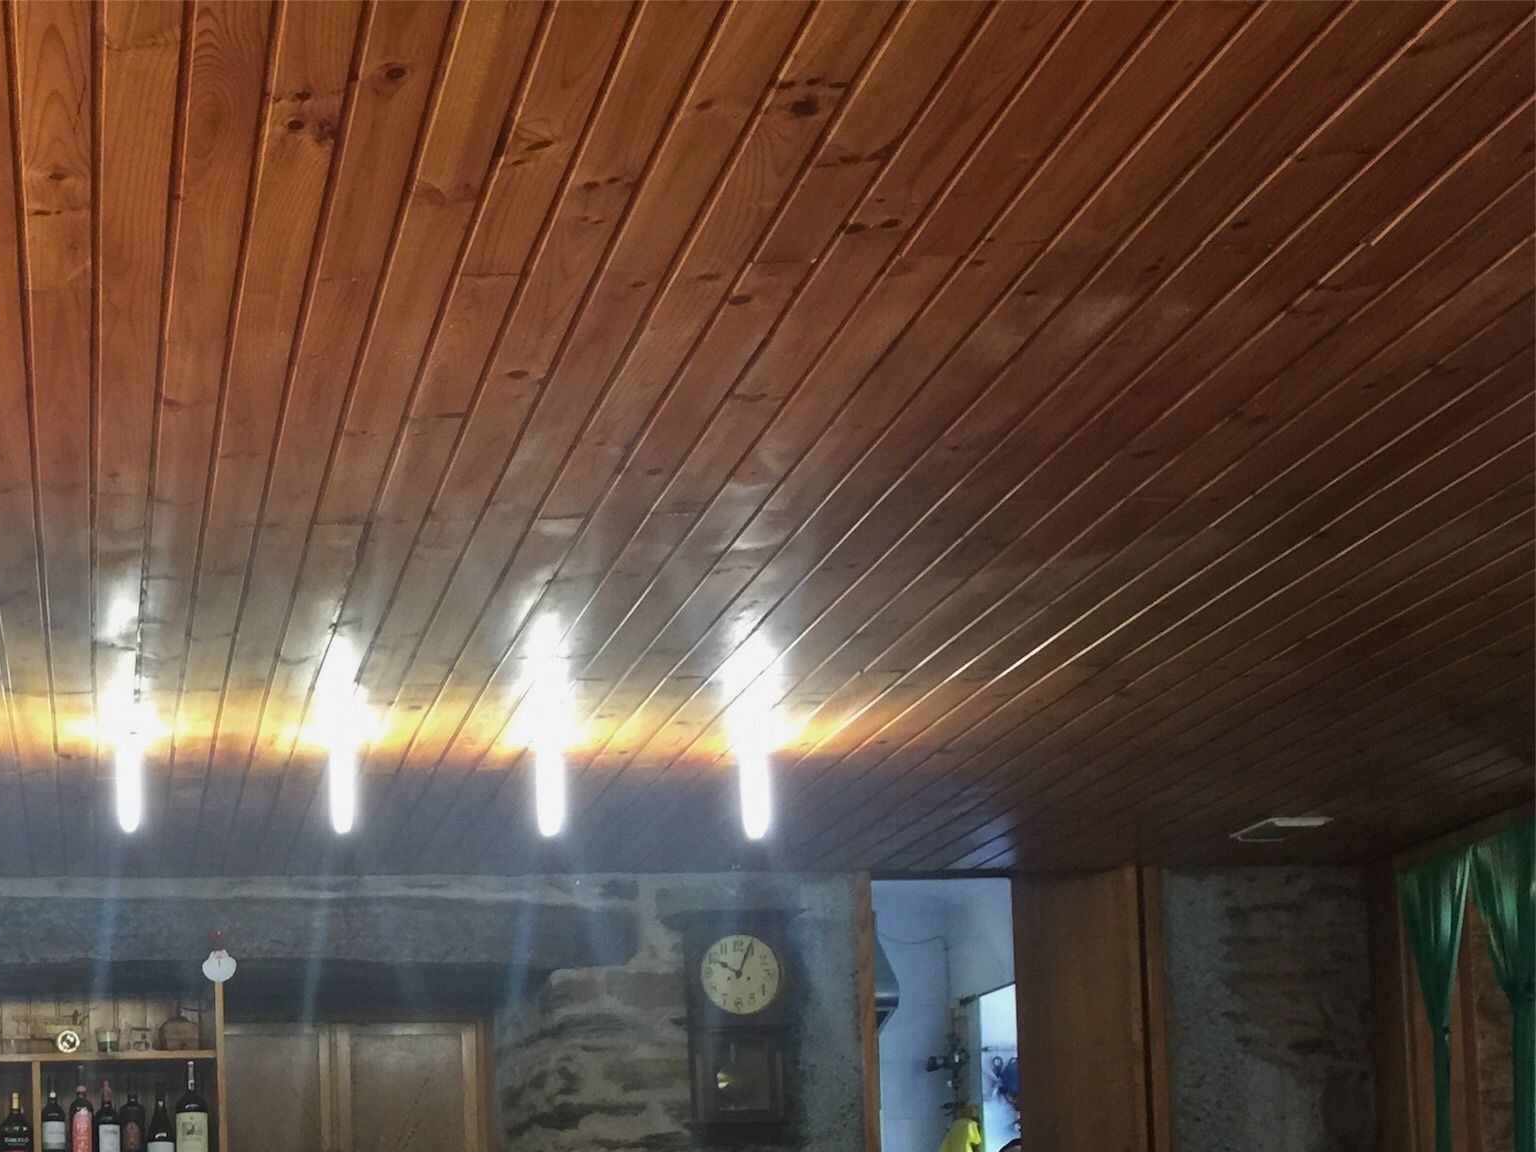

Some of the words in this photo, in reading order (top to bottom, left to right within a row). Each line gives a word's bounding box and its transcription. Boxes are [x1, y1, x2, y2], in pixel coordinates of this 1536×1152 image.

[720, 943, 728, 955] 11
[733, 940, 744, 952] 12
[759, 954, 768, 966] 2
[757, 983, 766, 996] 4
[721, 993, 729, 1006] 7
[734, 997, 743, 1011] 6
[748, 993, 757, 1005] 5
